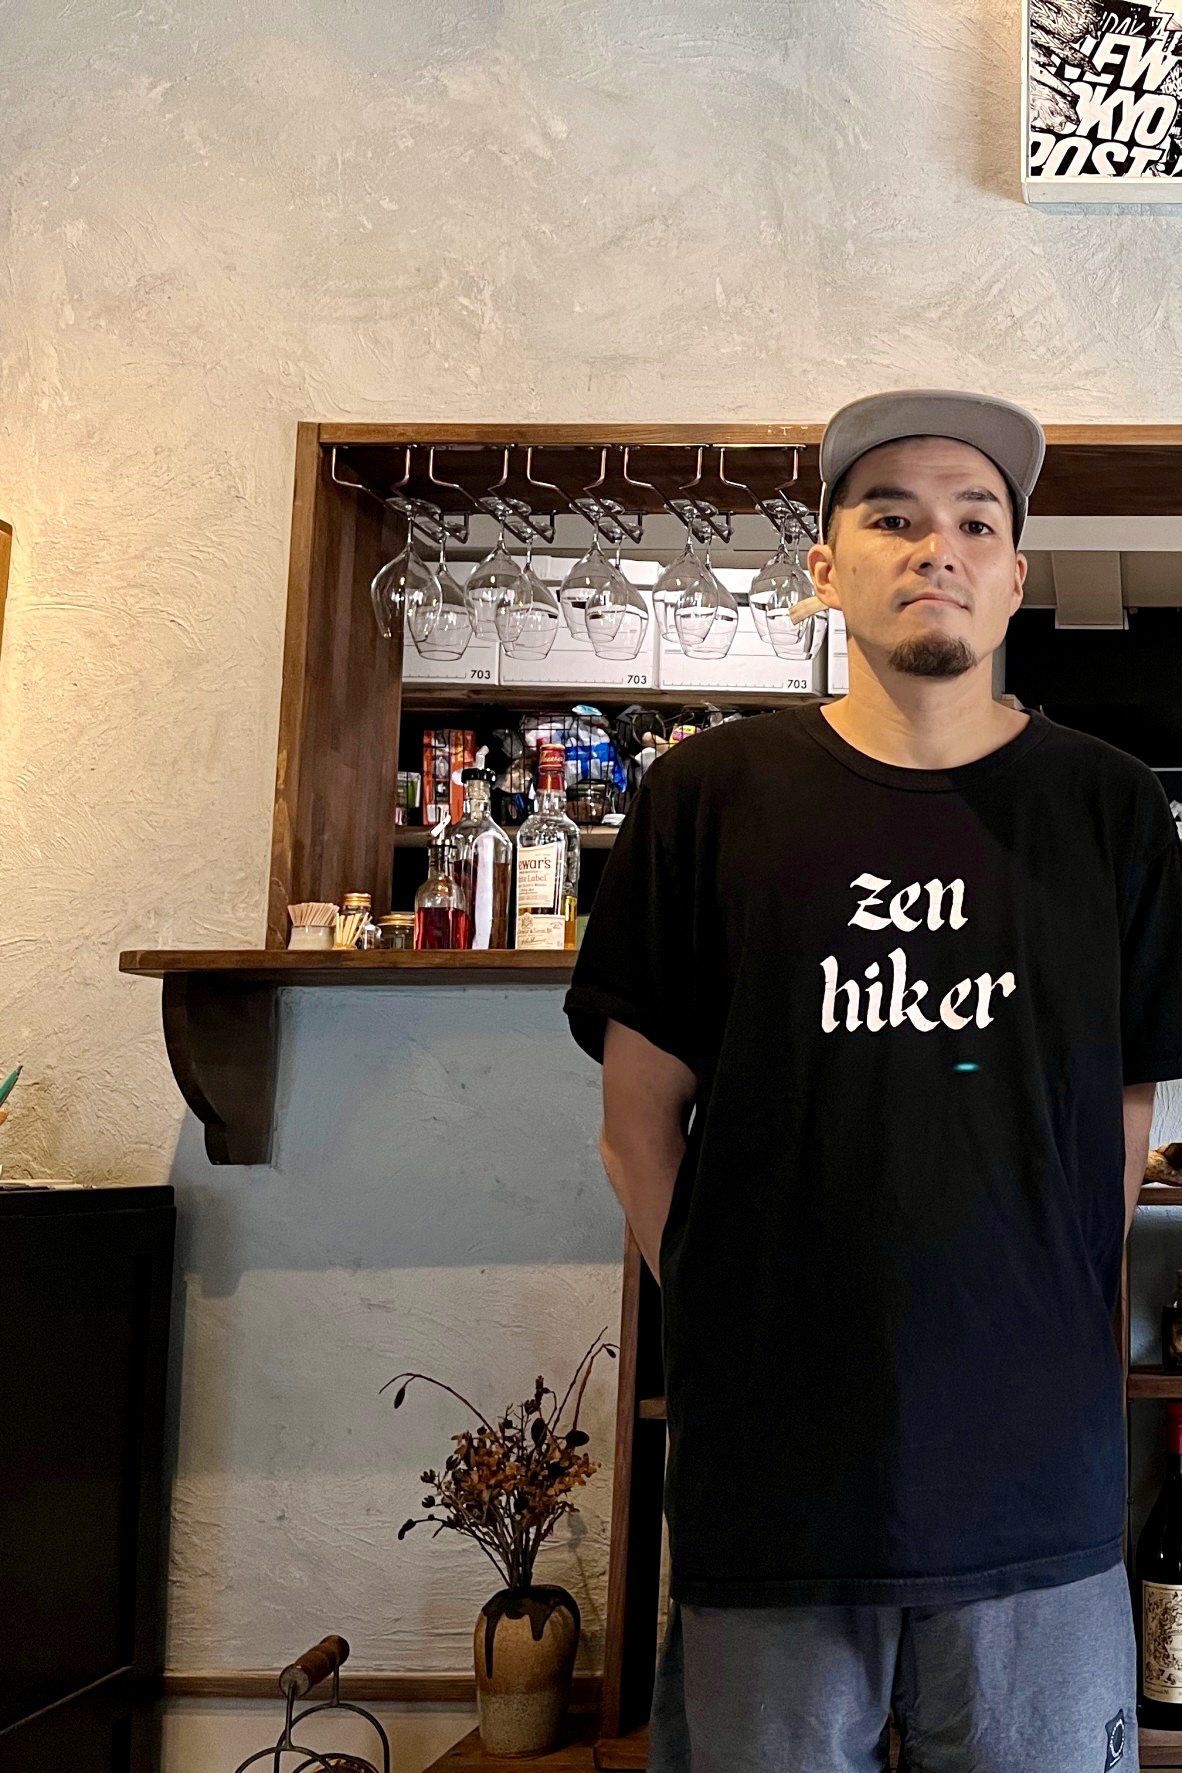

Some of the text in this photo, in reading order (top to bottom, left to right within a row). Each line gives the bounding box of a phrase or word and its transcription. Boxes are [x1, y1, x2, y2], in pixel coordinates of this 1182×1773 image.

[470, 669, 491, 680] 703
[627, 674, 648, 685] 703
[787, 679, 808, 690] 703
[518, 857, 552, 870] ewar's
[847, 872, 969, 932] zen
[819, 947, 1017, 1034] hiker
